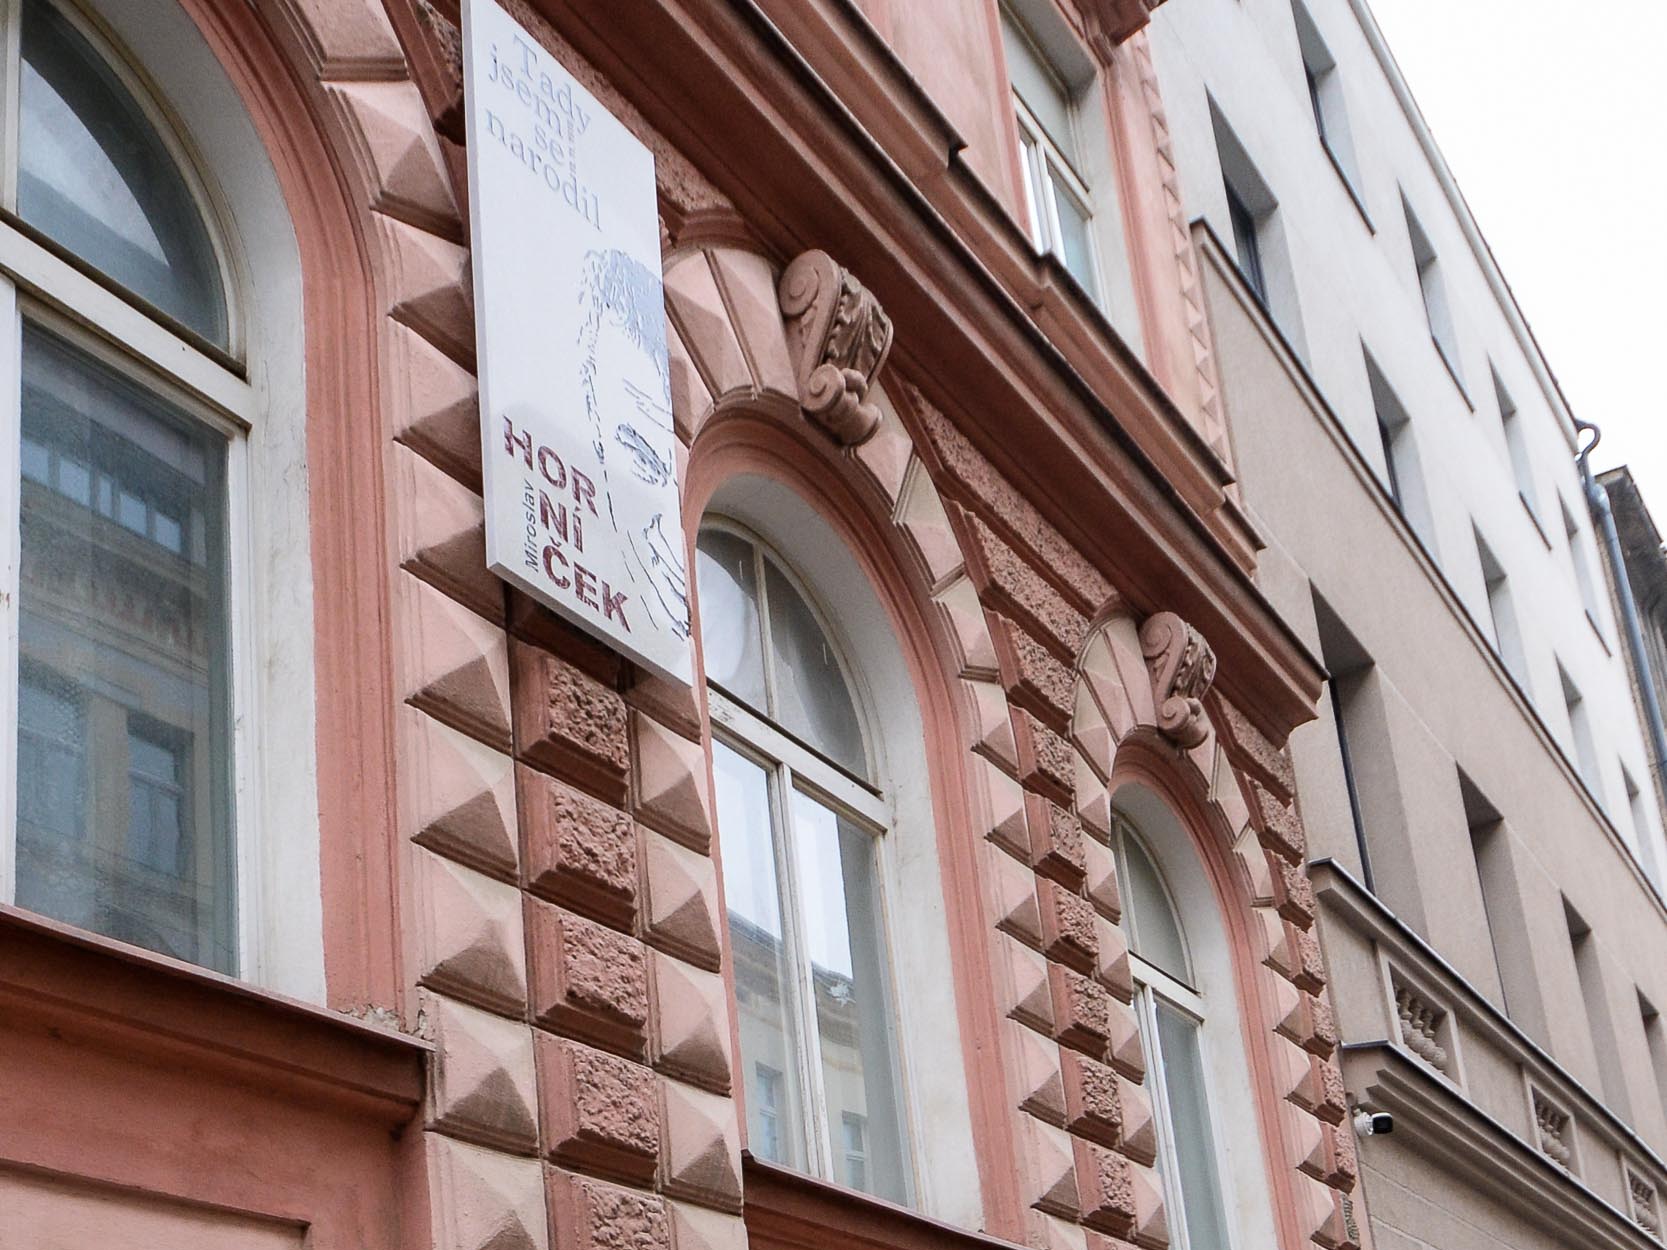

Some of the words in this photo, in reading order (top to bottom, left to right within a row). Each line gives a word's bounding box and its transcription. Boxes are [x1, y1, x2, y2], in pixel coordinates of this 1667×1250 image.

[488, 43, 563, 139] jsem
[513, 33, 591, 135] Tady
[486, 108, 602, 232] narodil
[534, 124, 565, 165] se
[502, 414, 599, 519] HOR
[522, 479, 539, 572] Miroslav
[542, 535, 631, 634] ČEK
